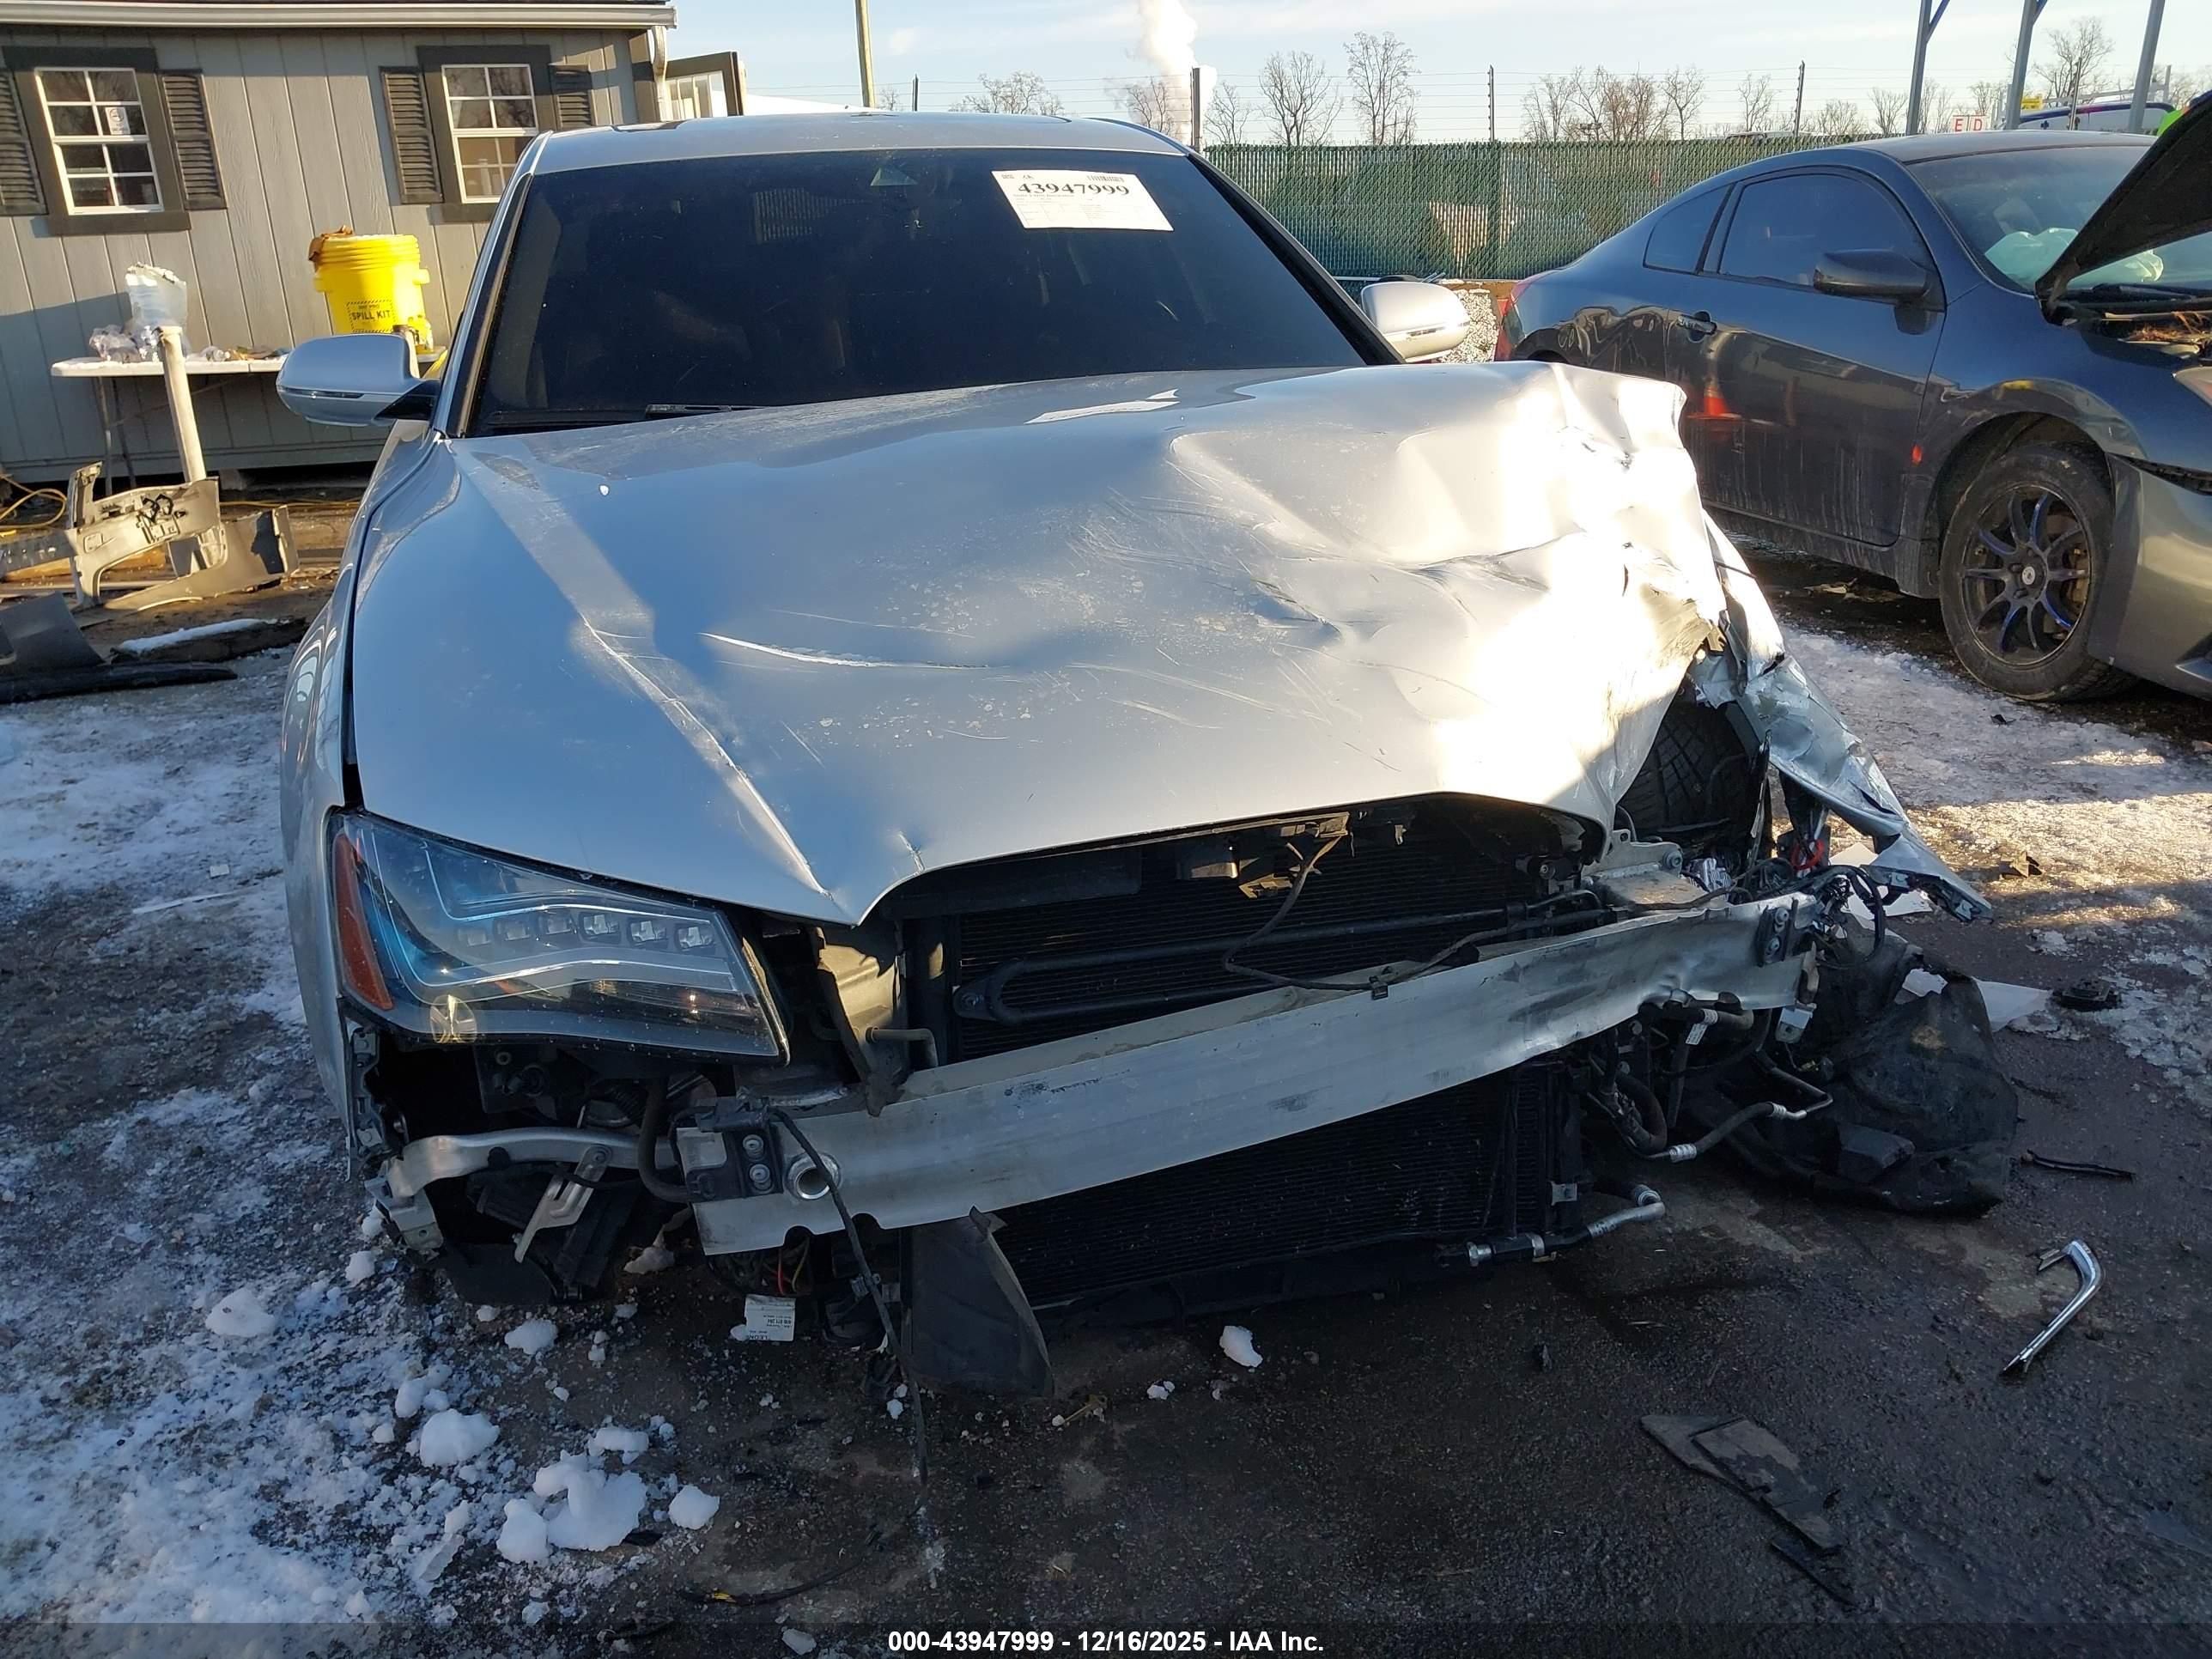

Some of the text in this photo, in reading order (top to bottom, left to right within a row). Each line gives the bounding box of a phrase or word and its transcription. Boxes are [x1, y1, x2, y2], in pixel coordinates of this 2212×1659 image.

[1954, 118, 1983, 131] E D
[1018, 183, 1130, 195] 43947999
[351, 310, 390, 320] SPILL KIT
